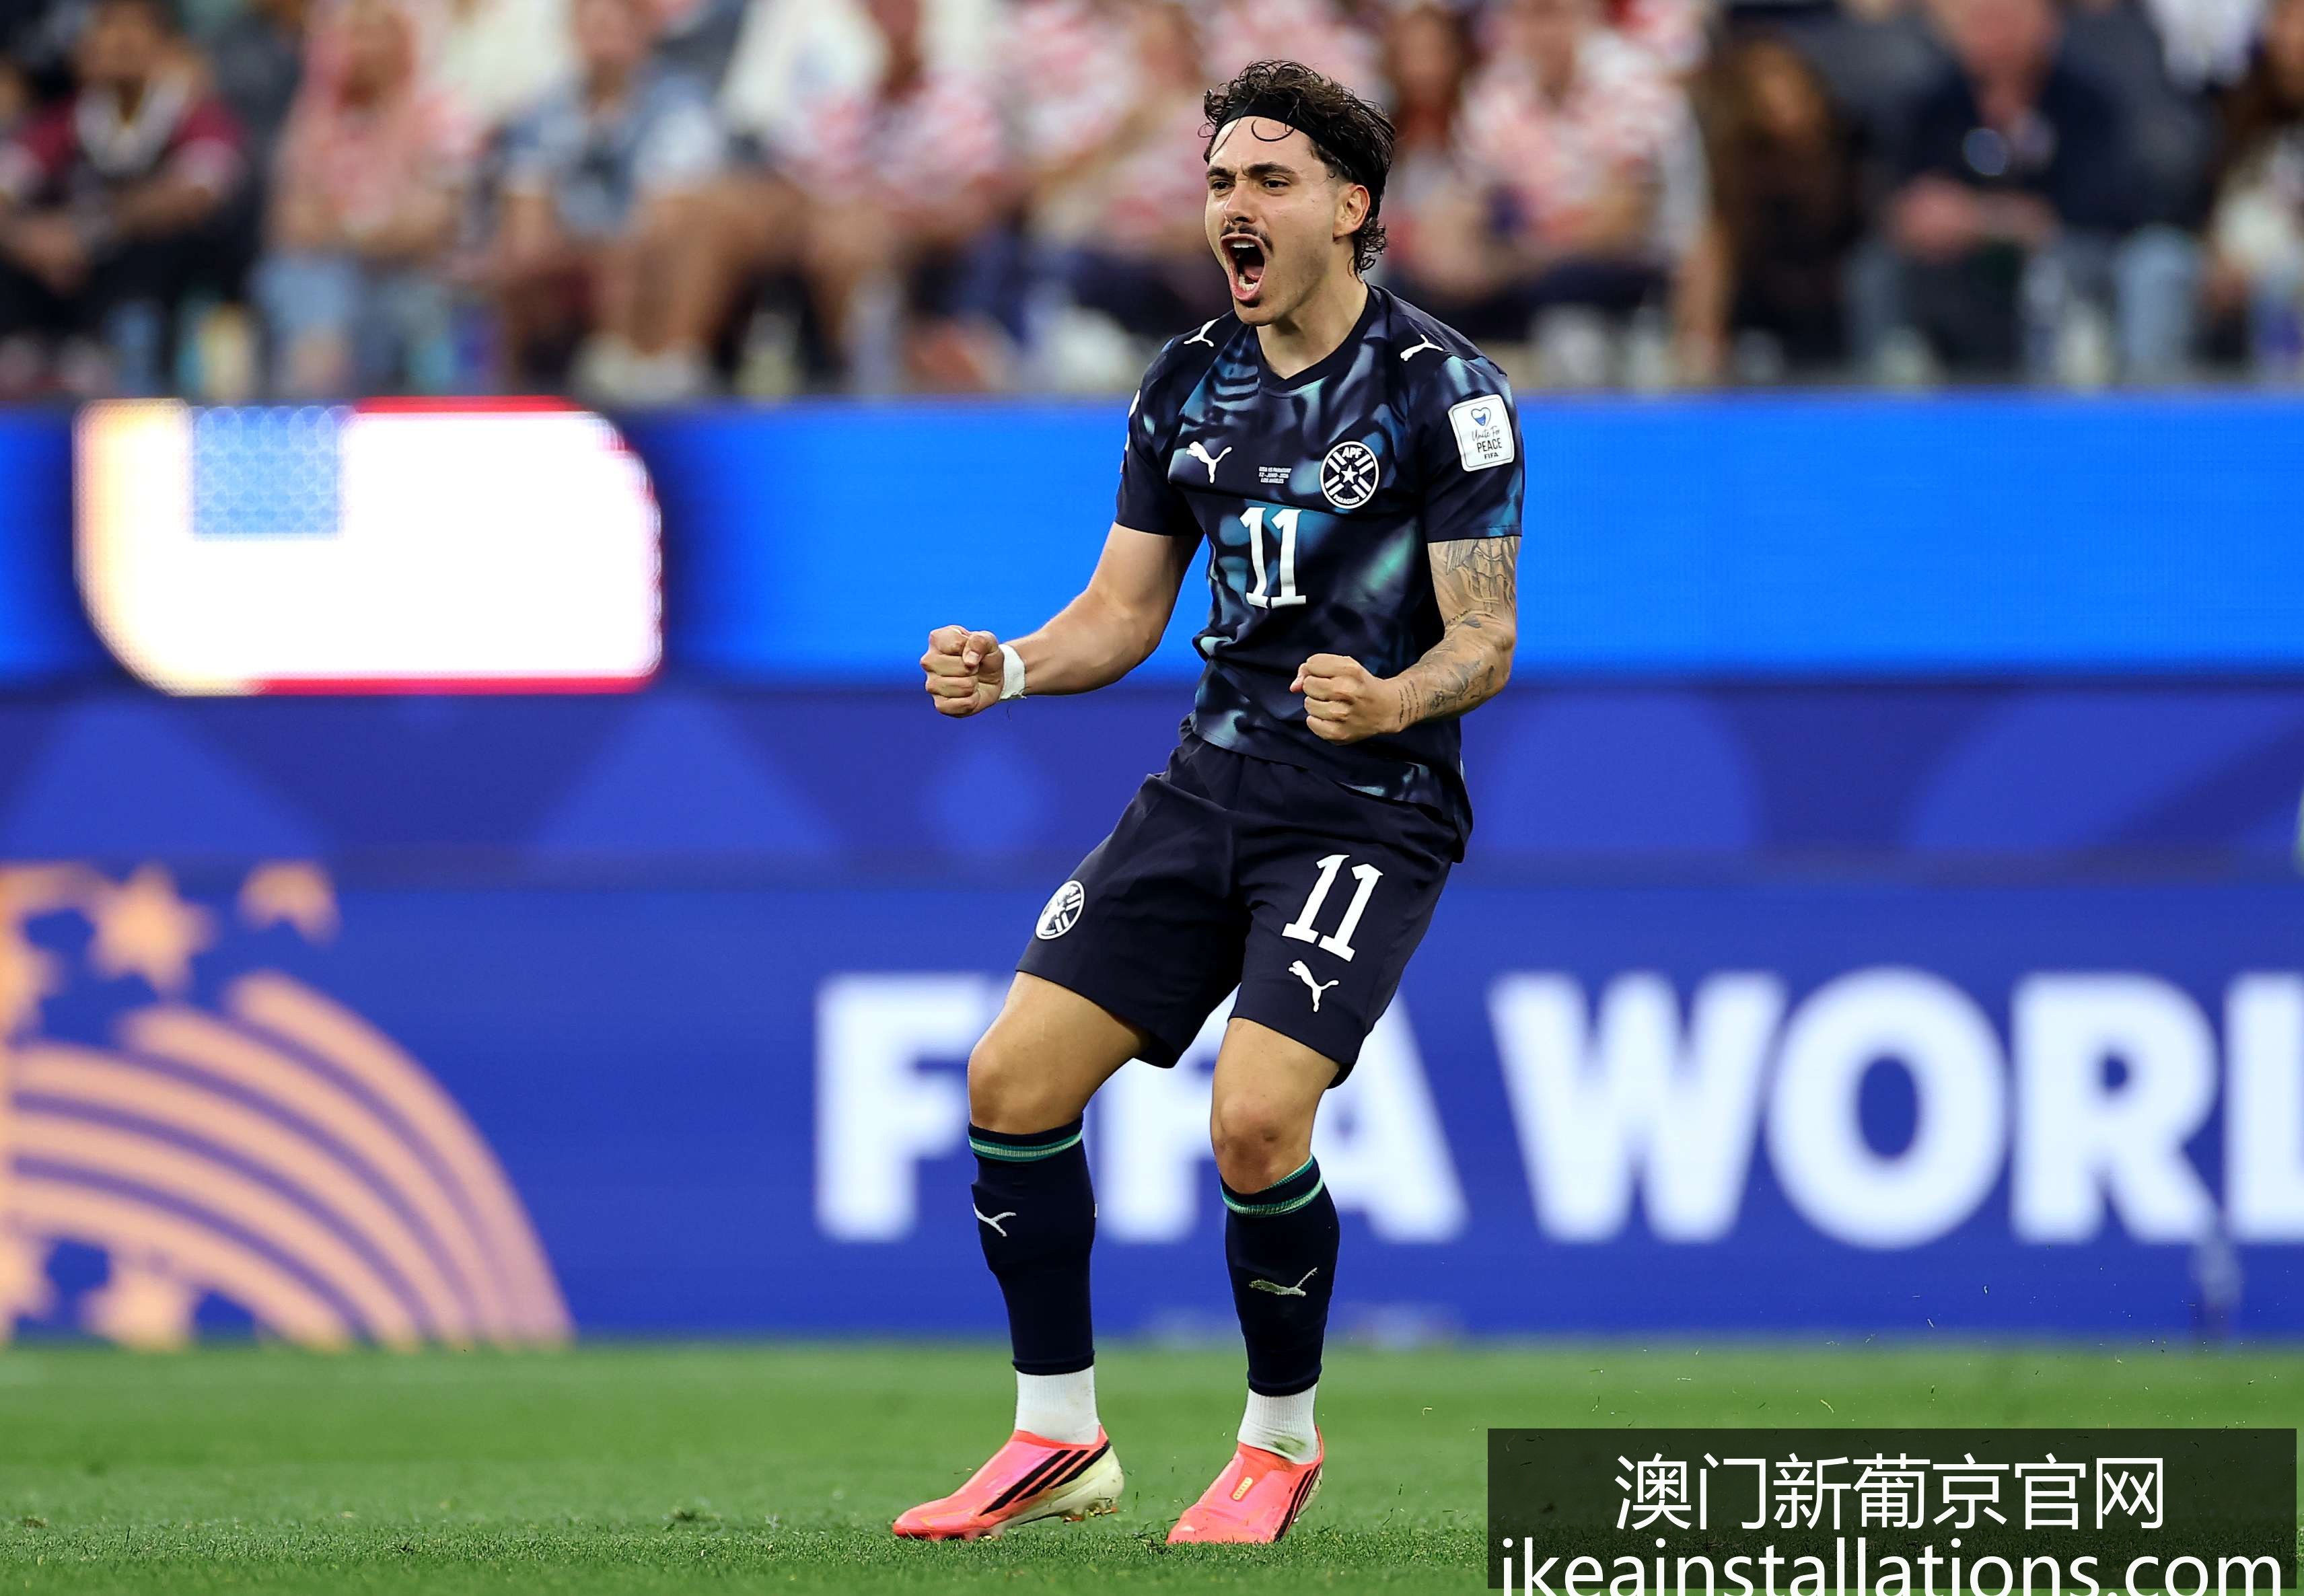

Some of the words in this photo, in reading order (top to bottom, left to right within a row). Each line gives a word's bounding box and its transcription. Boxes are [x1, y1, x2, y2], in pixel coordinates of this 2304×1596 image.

[1342, 447, 1363, 459] APF
[1476, 437, 1503, 453] PEACE
[1239, 507, 1307, 609] 11
[1281, 854, 1383, 962] 11
